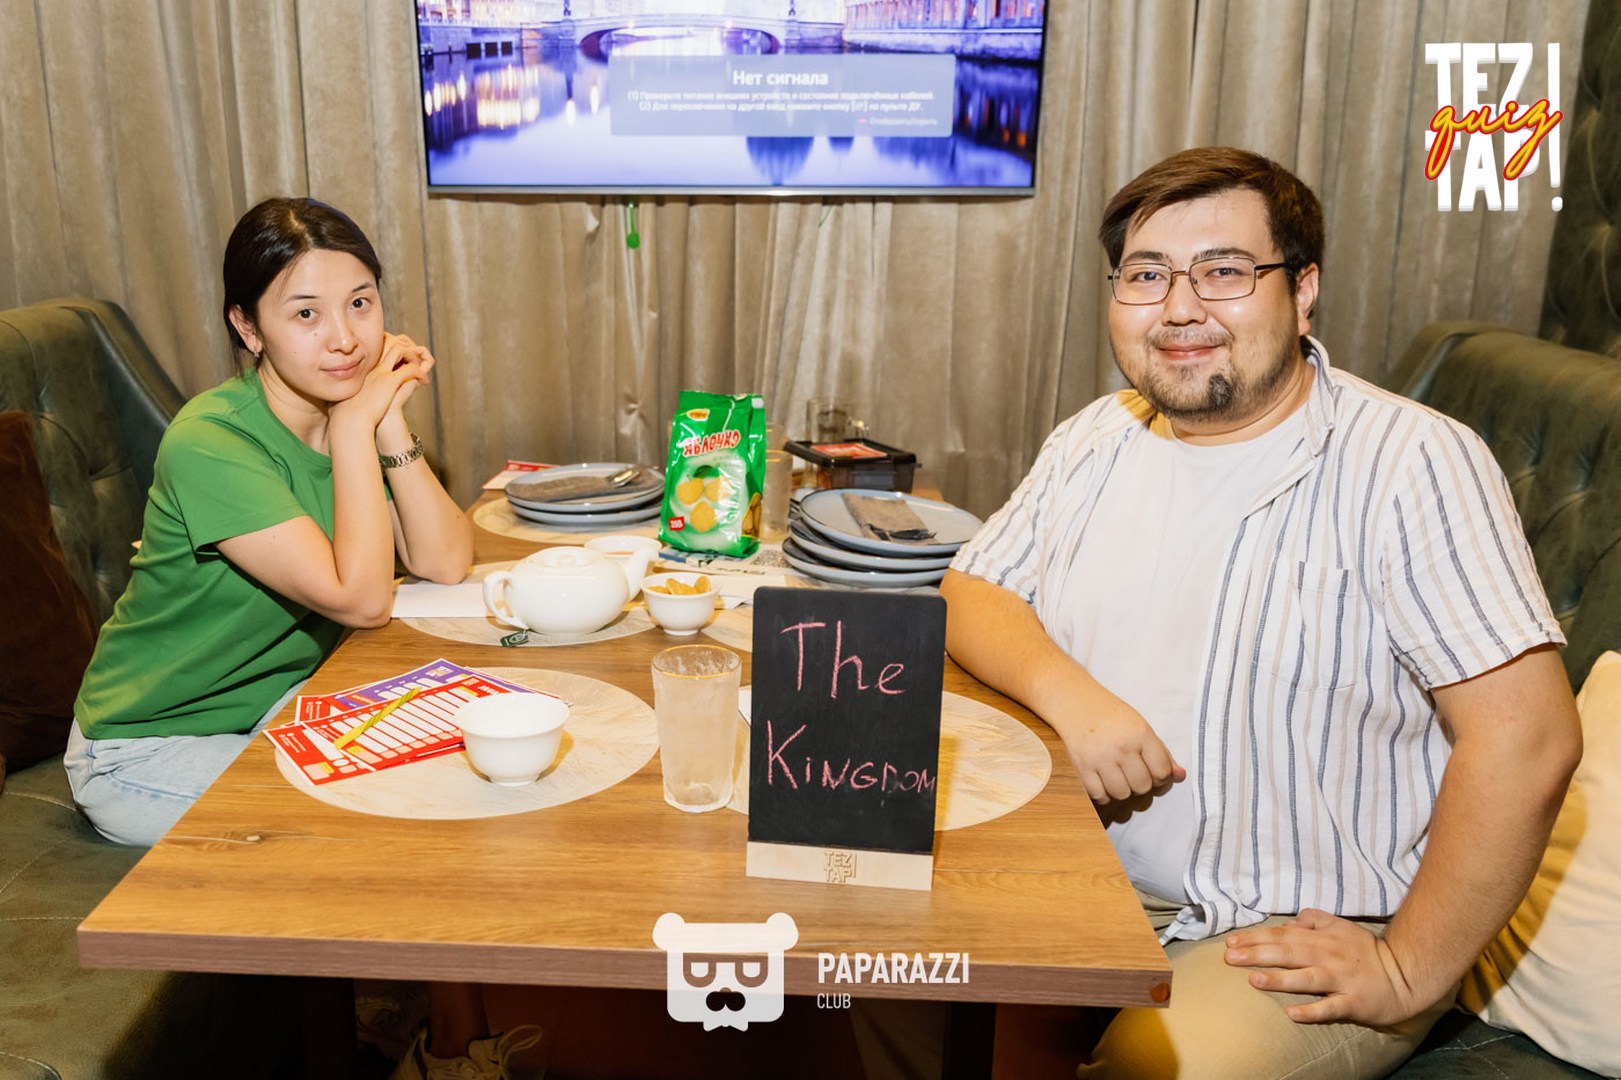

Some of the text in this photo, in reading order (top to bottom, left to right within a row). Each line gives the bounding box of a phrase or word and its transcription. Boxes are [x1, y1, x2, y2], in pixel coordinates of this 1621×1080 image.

[733, 70, 829, 86] Нет сигнала
[780, 619, 905, 699] The
[823, 851, 853, 868] TEZ
